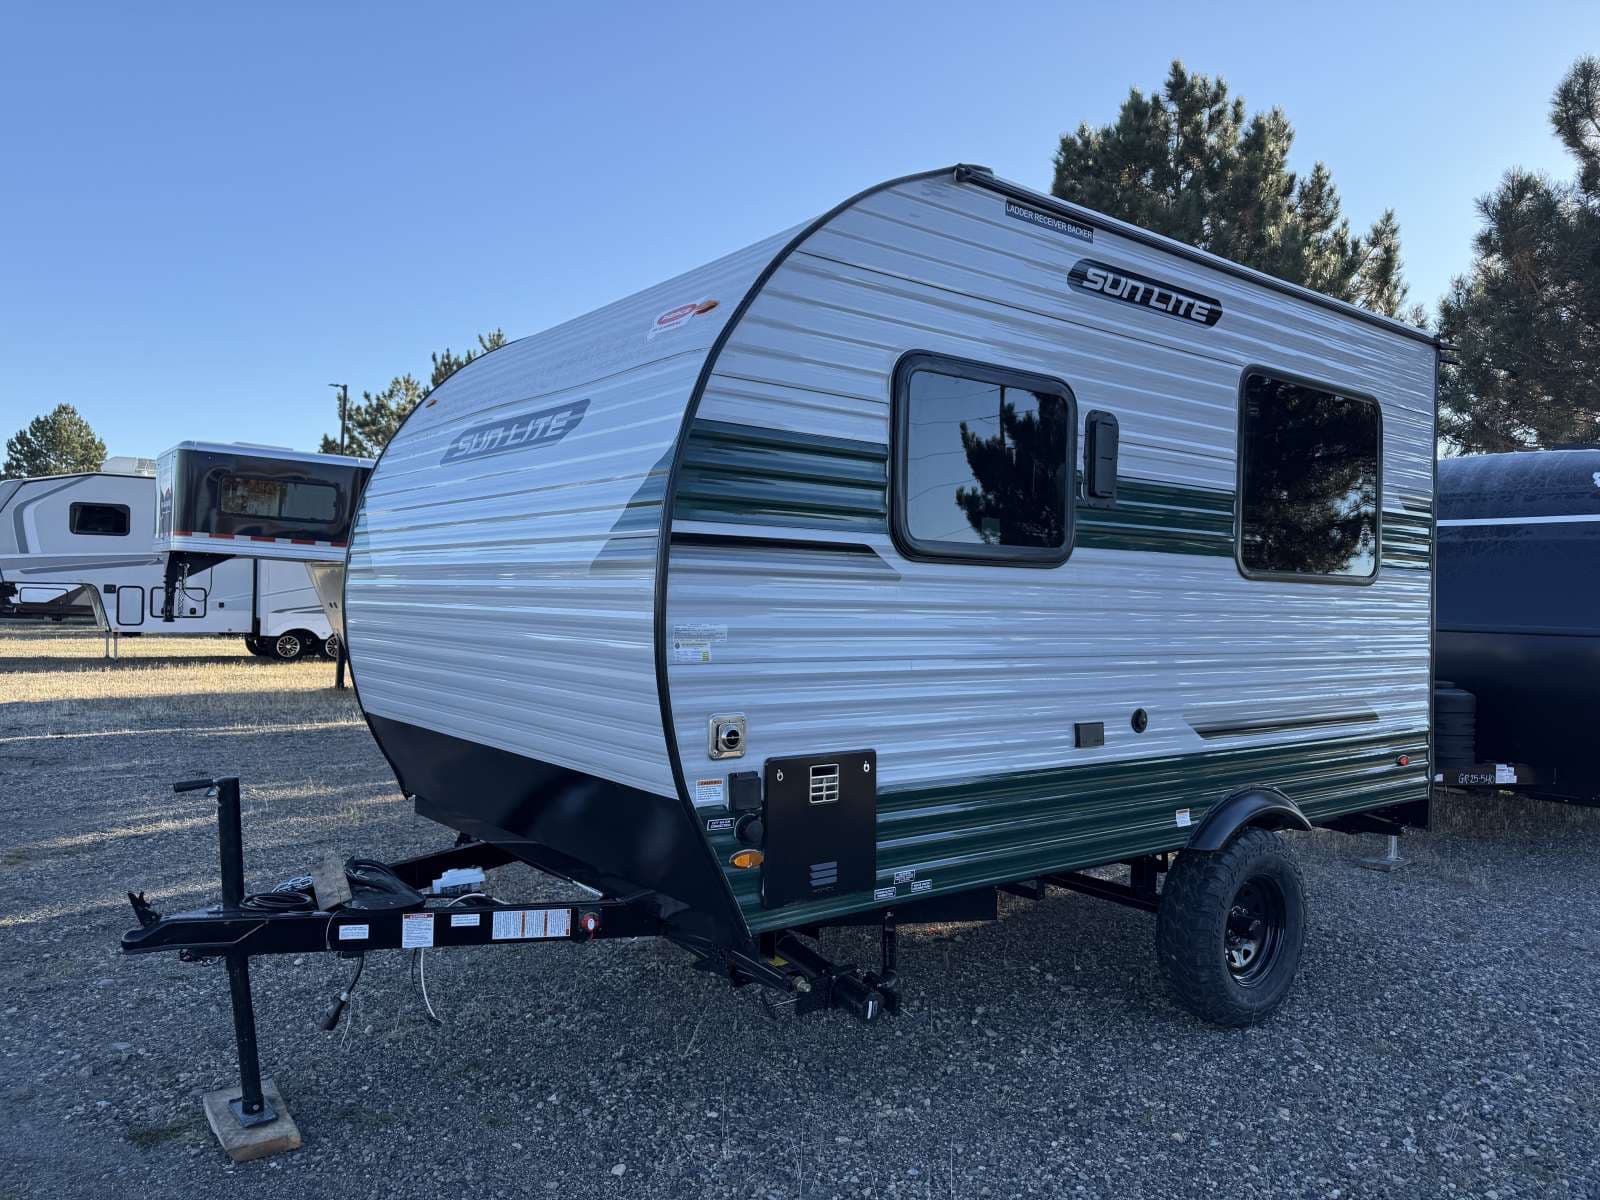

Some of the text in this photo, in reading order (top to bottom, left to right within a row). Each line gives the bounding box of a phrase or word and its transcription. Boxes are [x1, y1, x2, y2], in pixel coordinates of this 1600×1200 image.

[1006, 203, 1093, 240] LADDER RECEIVER BACKER
